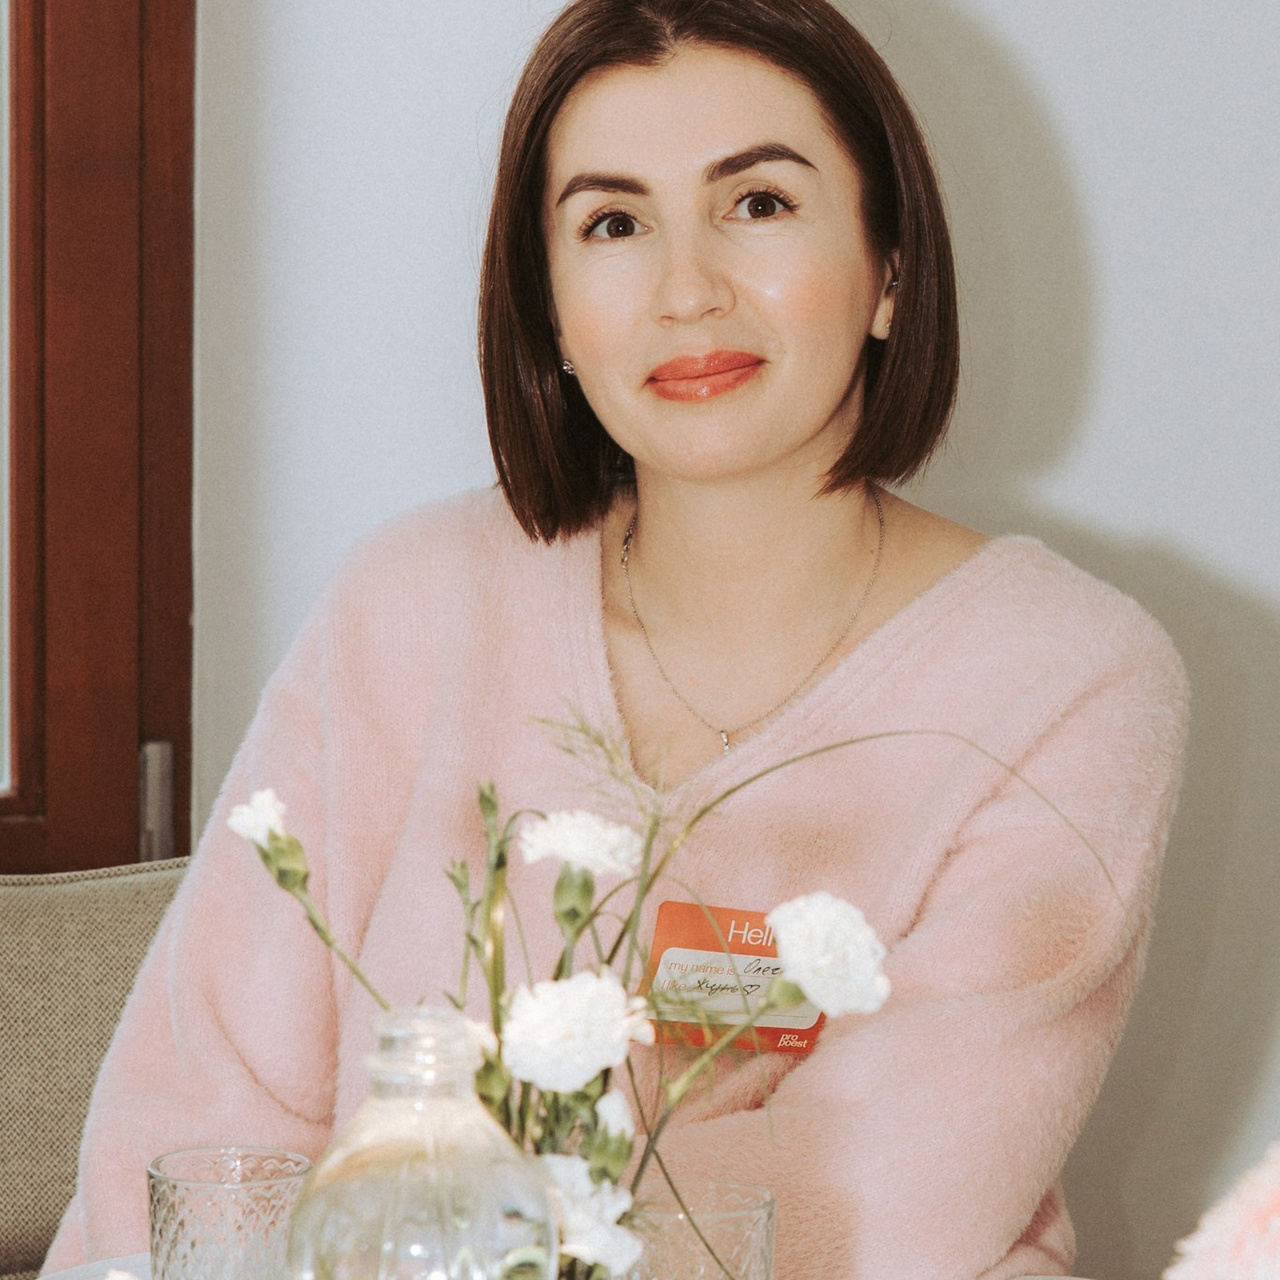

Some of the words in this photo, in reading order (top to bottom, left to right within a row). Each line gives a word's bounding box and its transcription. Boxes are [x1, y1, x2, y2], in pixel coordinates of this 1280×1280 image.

[727, 919, 775, 947] Hell
[668, 961, 688, 975] my
[690, 963, 725, 975] name
[726, 966, 736, 976] is
